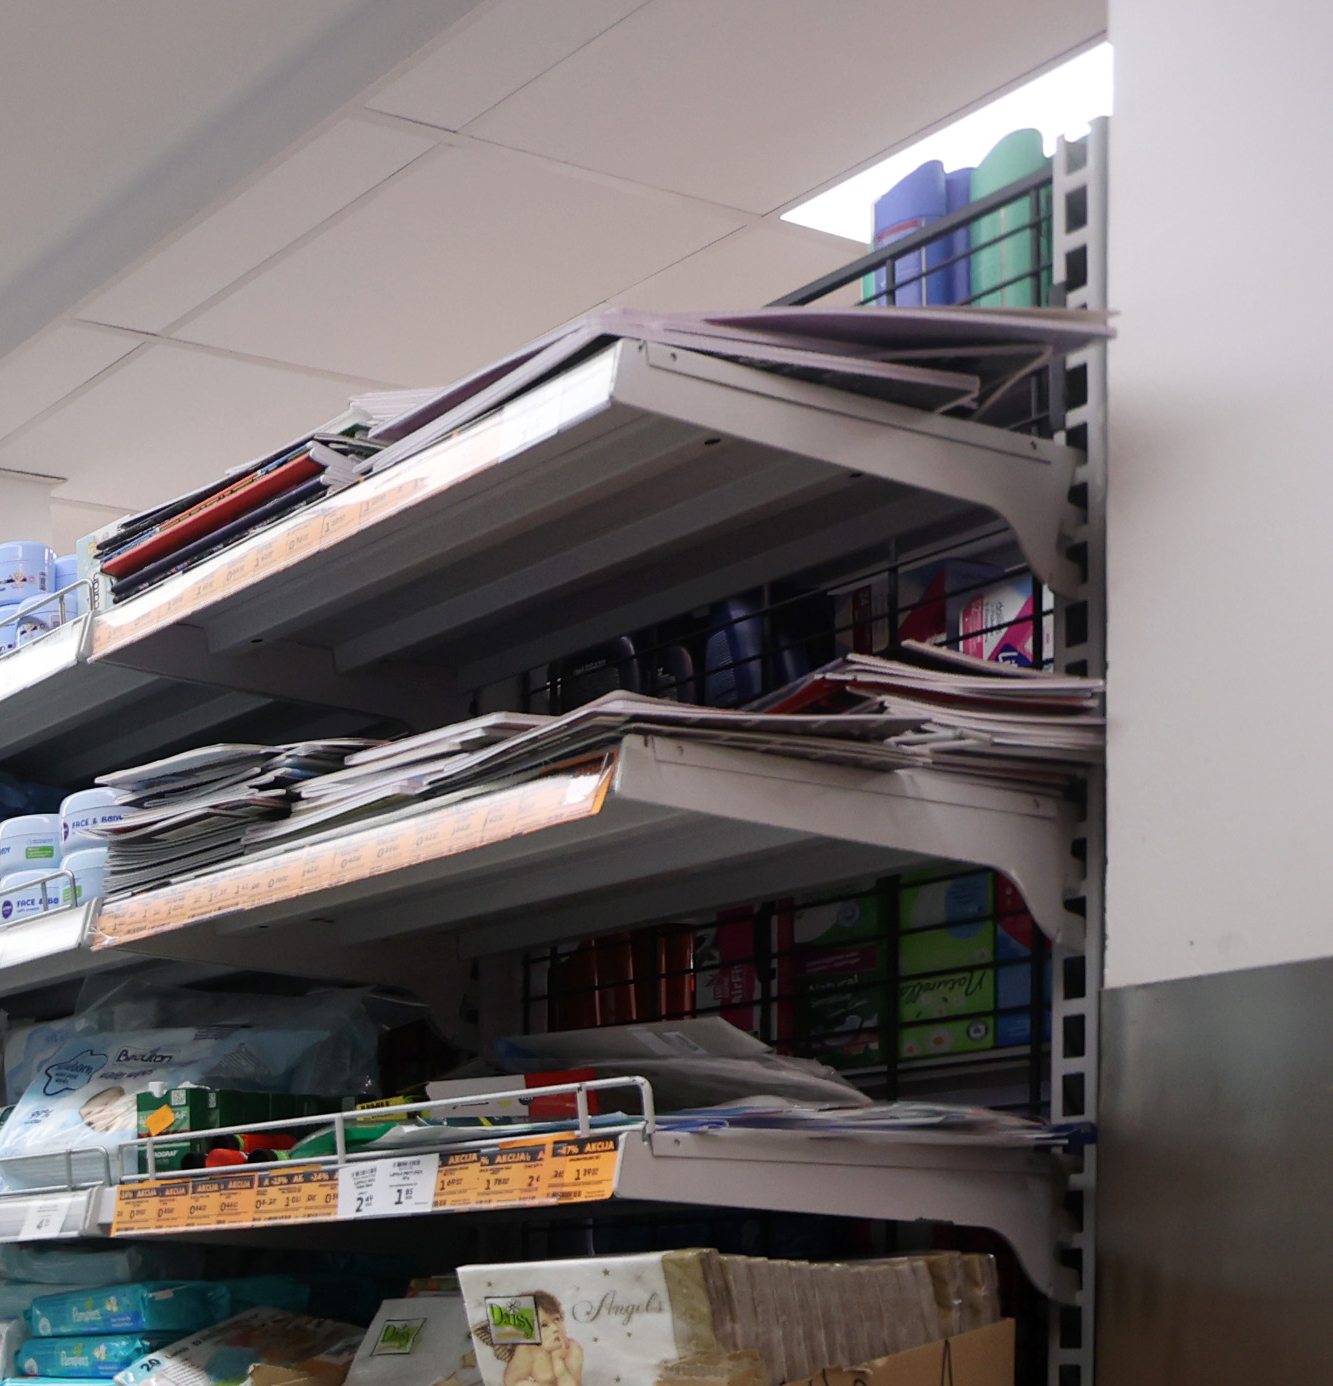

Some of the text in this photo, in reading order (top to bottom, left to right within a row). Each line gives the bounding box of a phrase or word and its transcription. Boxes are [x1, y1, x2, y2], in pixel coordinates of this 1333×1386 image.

[72, 818, 91, 830] FACE
[584, 1139, 615, 1153] AKCIJA
[572, 1290, 664, 1325] Angels
[489, 1302, 538, 1343] Daisy
[140, 1357, 162, 1373] 20
